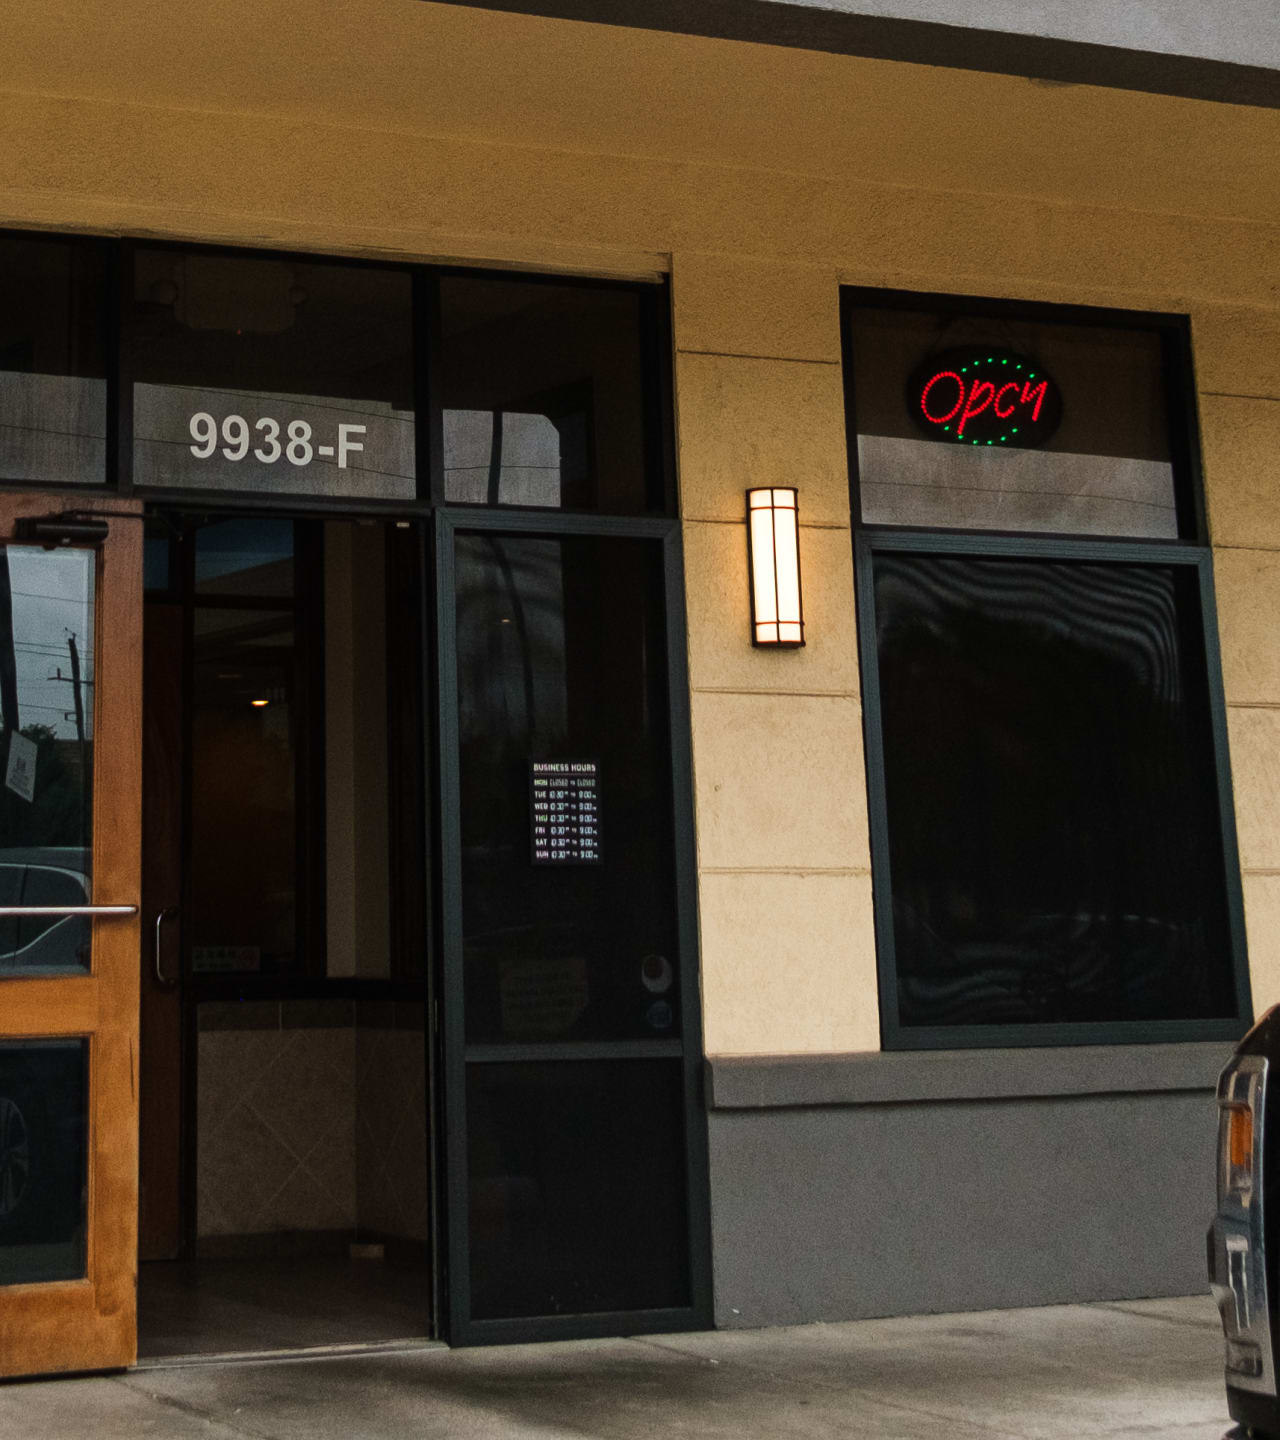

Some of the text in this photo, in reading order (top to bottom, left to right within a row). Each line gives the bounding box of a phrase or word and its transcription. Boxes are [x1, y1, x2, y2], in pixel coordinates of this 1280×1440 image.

[188, 411, 368, 469] 9938-F
[533, 763, 596, 772] BUSINESS HOURS
